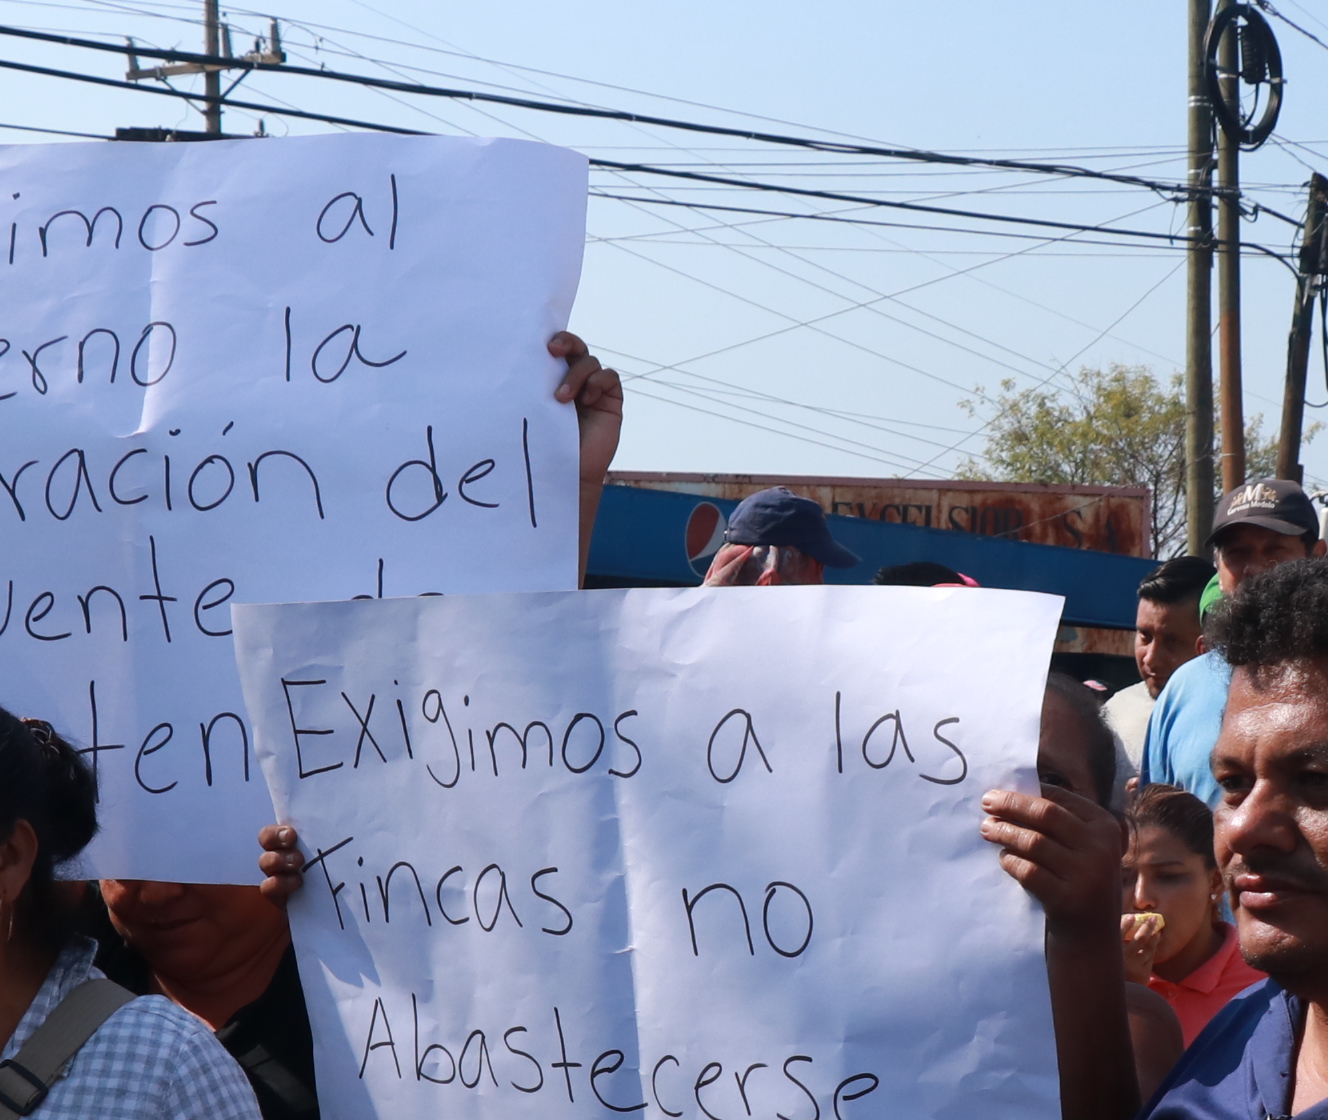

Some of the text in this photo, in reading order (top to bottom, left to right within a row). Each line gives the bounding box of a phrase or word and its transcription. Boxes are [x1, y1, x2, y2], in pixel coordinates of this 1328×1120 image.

[316, 174, 398, 250] al
[285, 307, 407, 384] la
[386, 418, 539, 528] del
[281, 677, 968, 788] Exigimos a las
[301, 836, 813, 957] Fincas no
